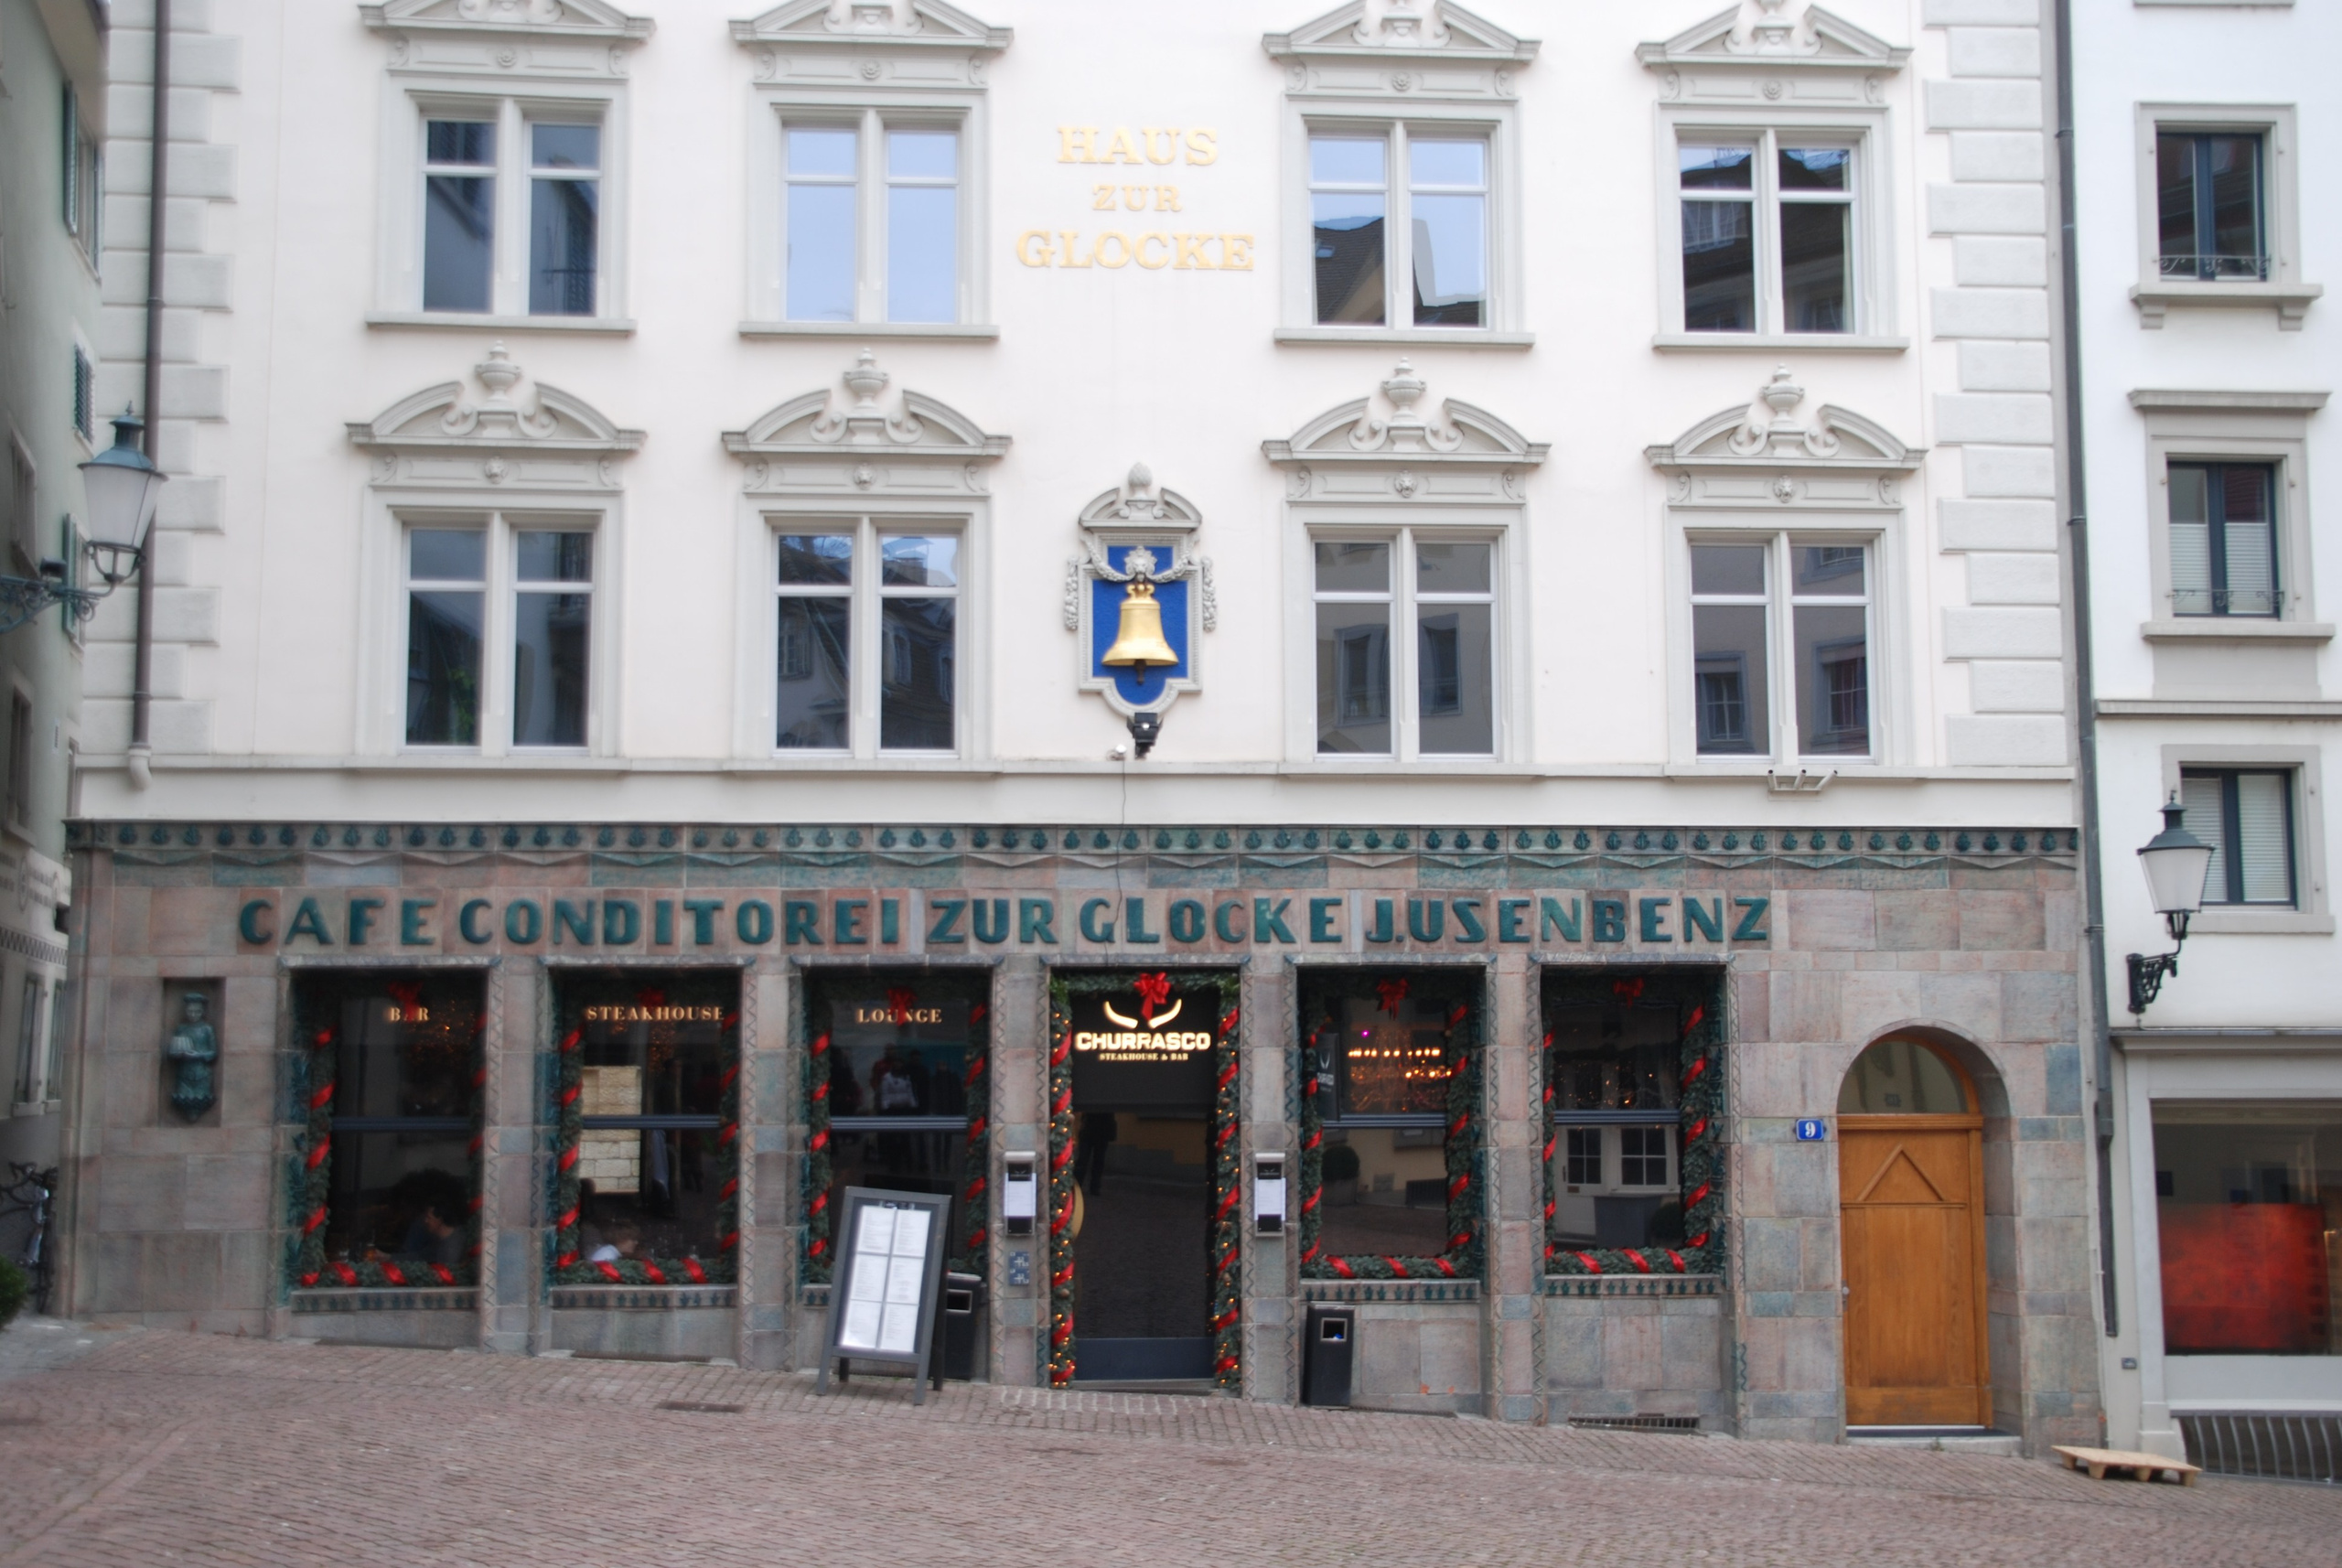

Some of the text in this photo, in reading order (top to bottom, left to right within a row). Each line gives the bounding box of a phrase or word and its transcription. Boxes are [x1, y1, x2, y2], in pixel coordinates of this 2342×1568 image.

[1057, 125, 1219, 166] HAUS
[1092, 185, 1183, 212] ZUR
[1015, 230, 1255, 271] GLOCKE
[239, 897, 435, 946] CAFE
[459, 897, 899, 946] CONDITOREI
[926, 897, 1058, 945] ZUR
[1079, 897, 1343, 945] GLOCKE
[390, 1007, 430, 1022] BR
[586, 1006, 725, 1022] STEAKHOUSE
[1075, 1032, 1211, 1051] CHURRASCO
[1099, 1052, 1189, 1061] STEAKHOUSE & BAR
[1805, 1122, 1816, 1138] 9
